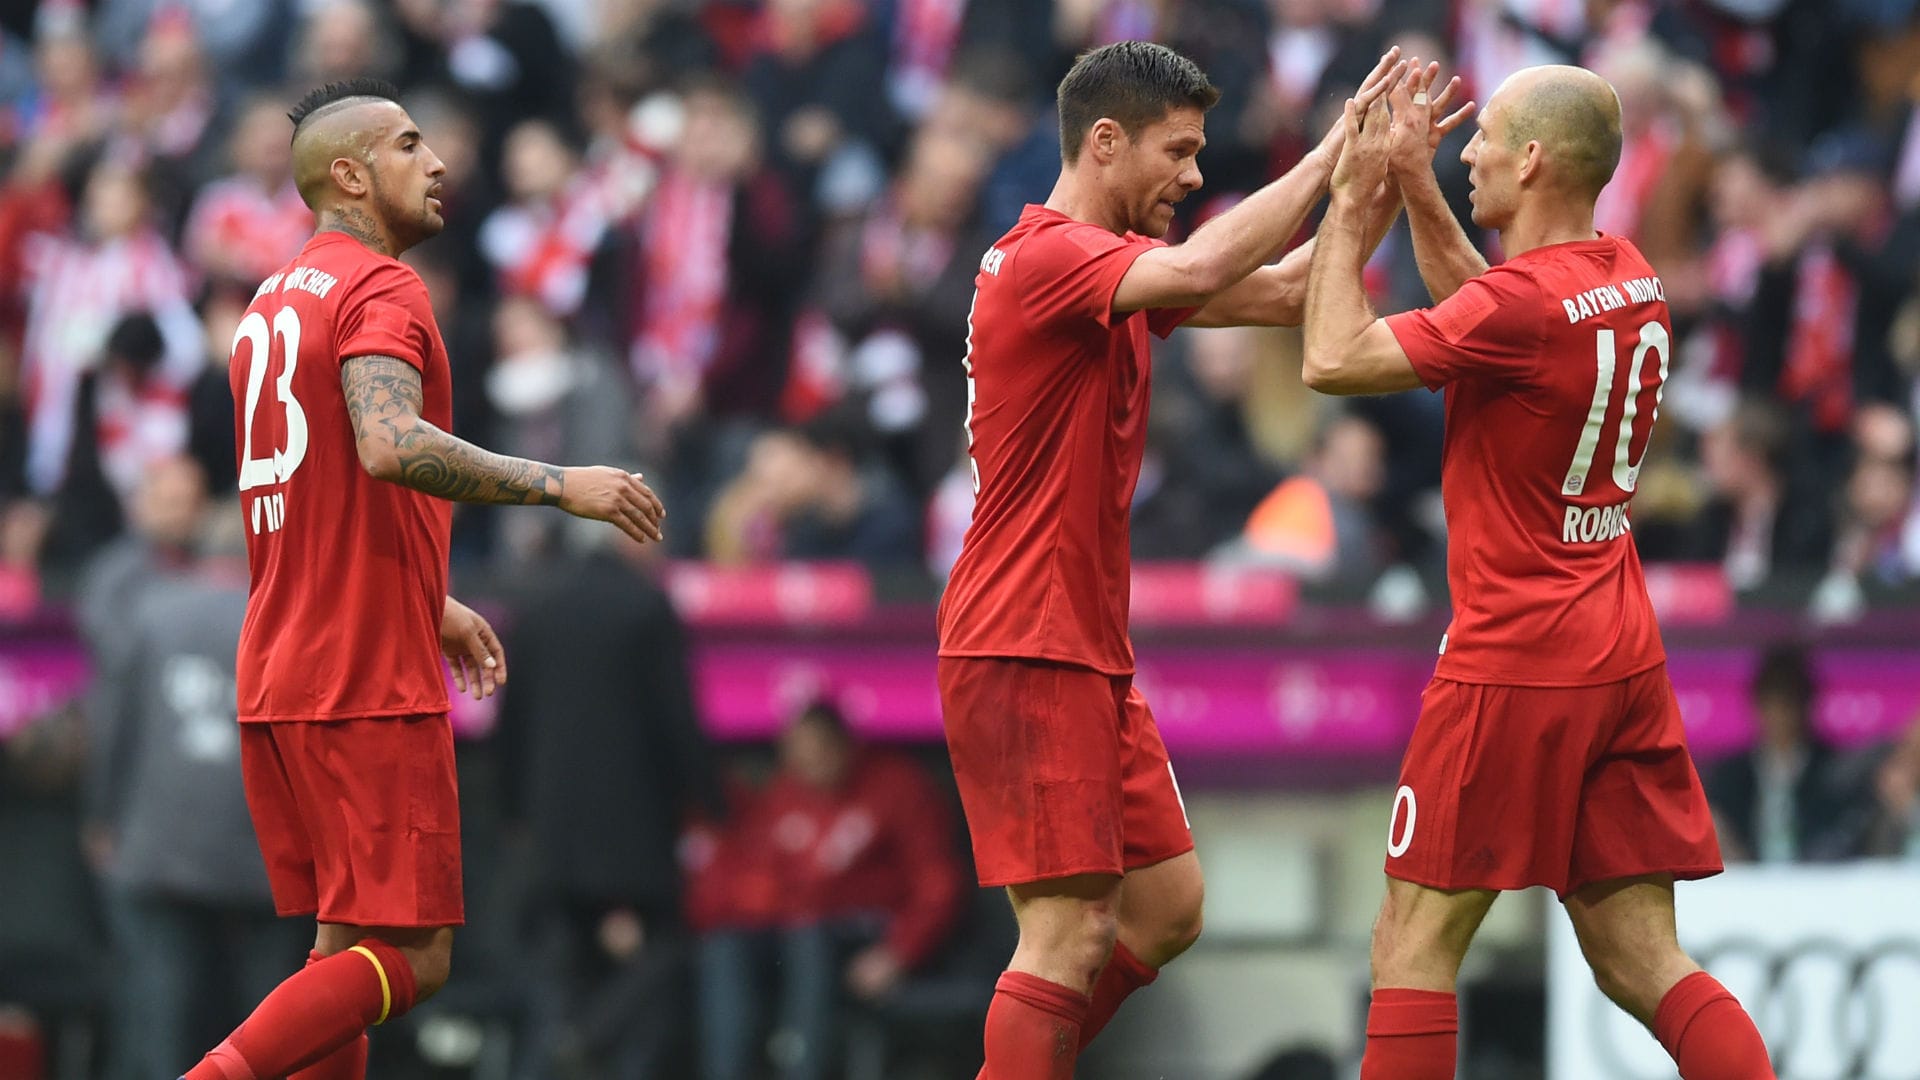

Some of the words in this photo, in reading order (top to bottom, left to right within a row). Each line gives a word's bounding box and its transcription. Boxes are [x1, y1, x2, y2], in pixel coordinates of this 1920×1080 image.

[1562, 284, 1627, 325] BAYERN
[231, 305, 309, 492] 23
[1561, 320, 1670, 496] 10
